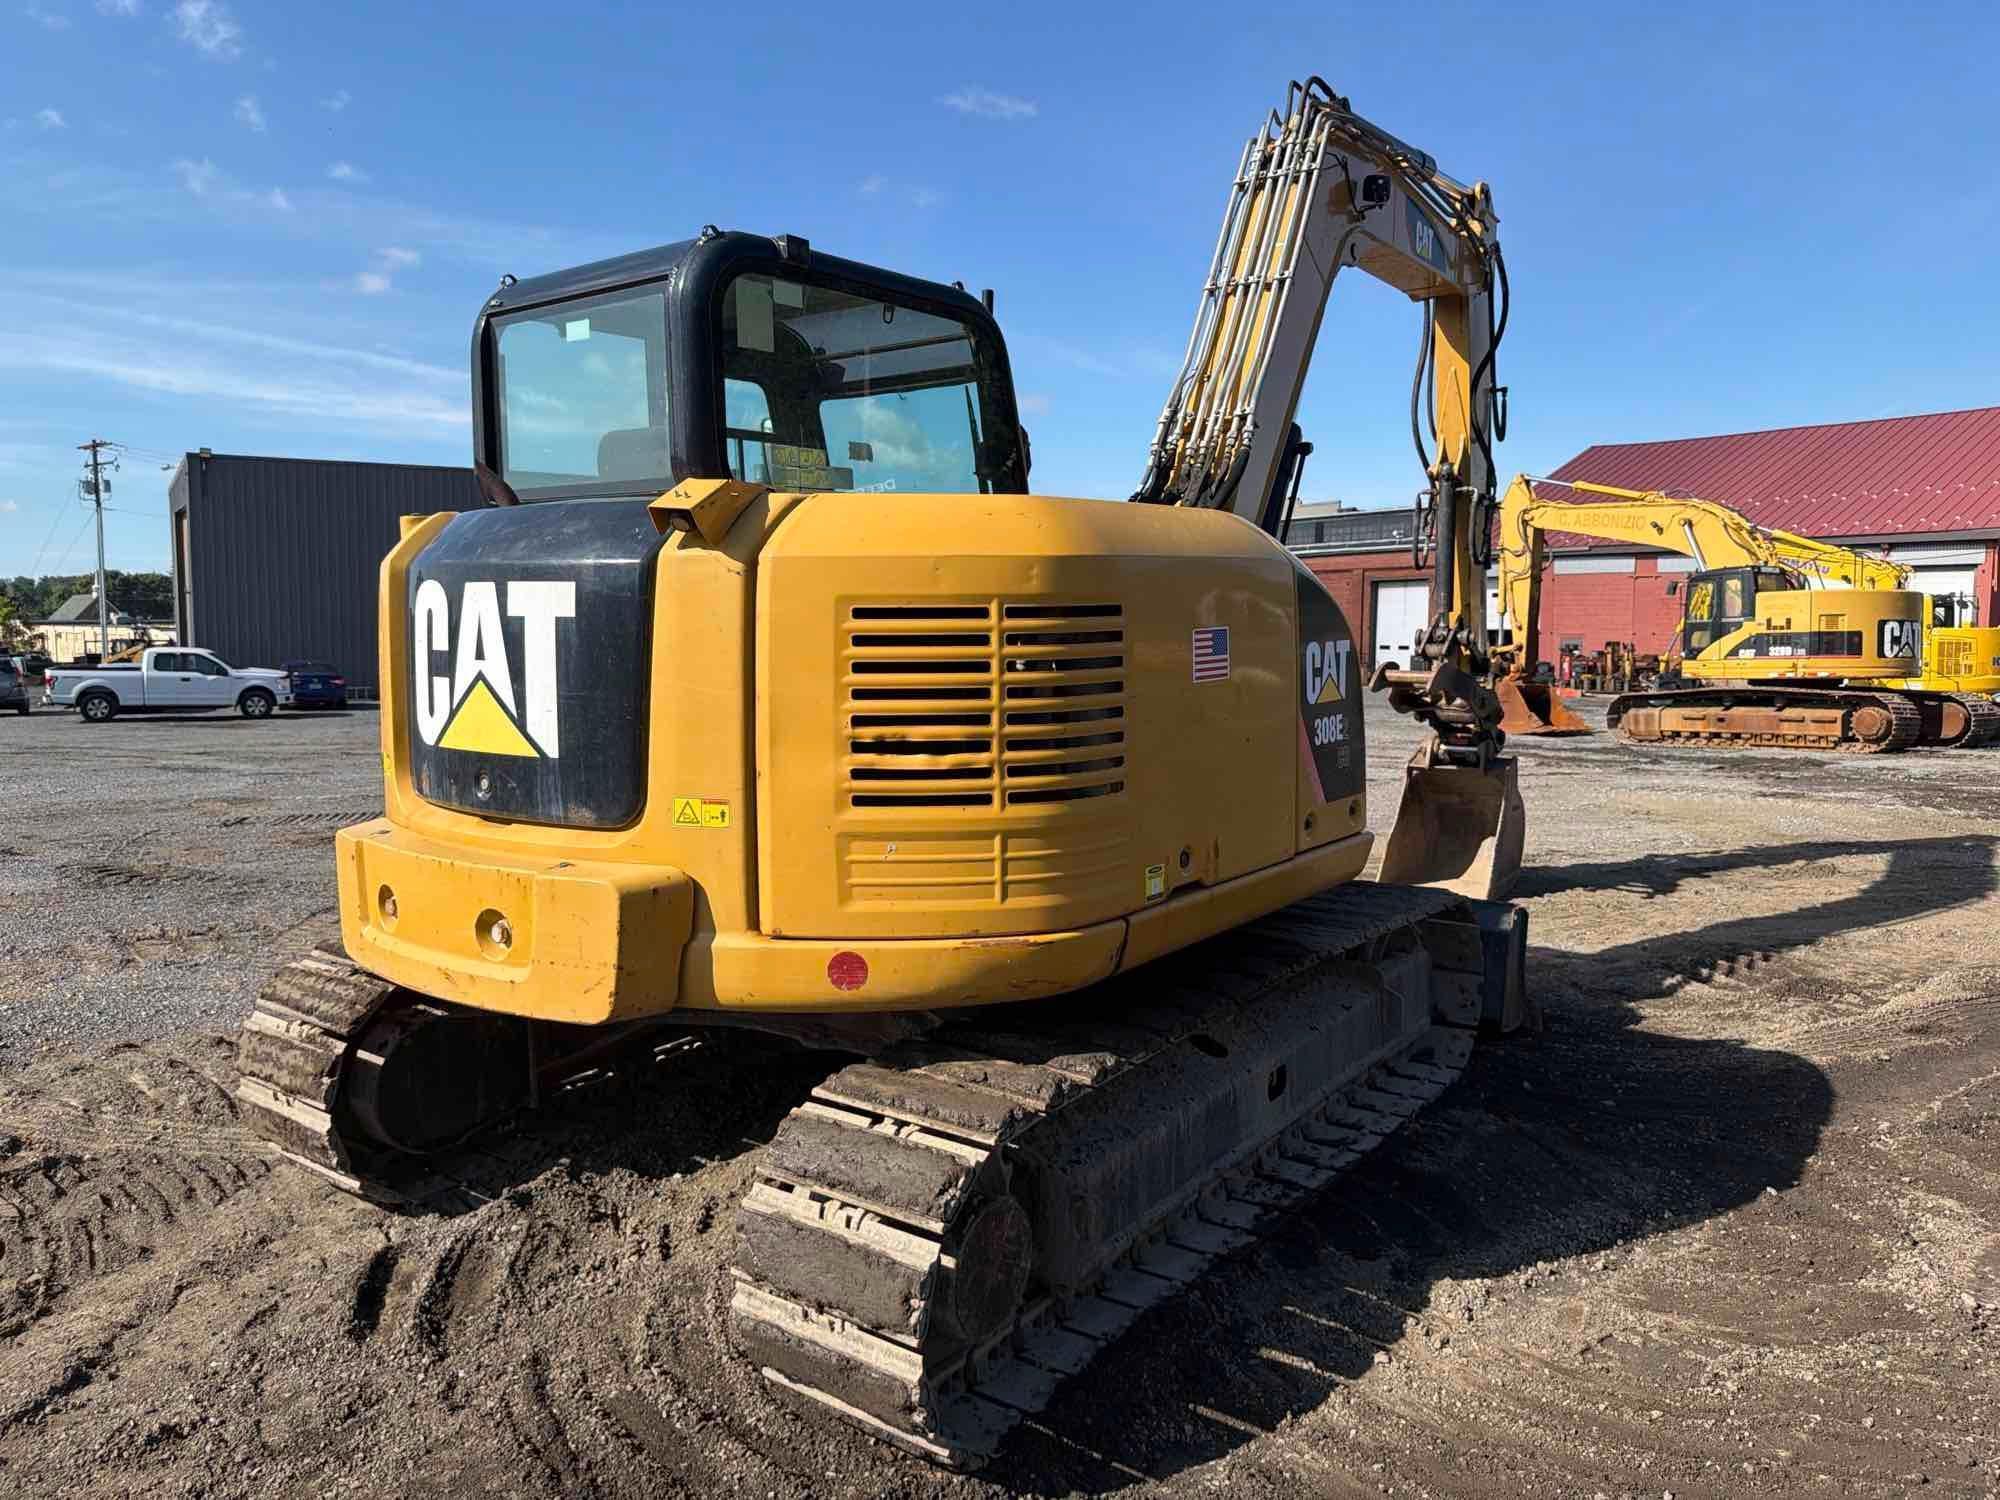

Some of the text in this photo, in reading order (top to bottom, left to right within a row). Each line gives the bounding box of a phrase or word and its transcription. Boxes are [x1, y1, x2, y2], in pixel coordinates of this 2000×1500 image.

[1416, 220, 1434, 260] CAT
[1884, 621, 1920, 658] CAT
[414, 579, 576, 758] CAT
[1305, 640, 1350, 704] CAT
[1314, 713, 1344, 746] 308E
